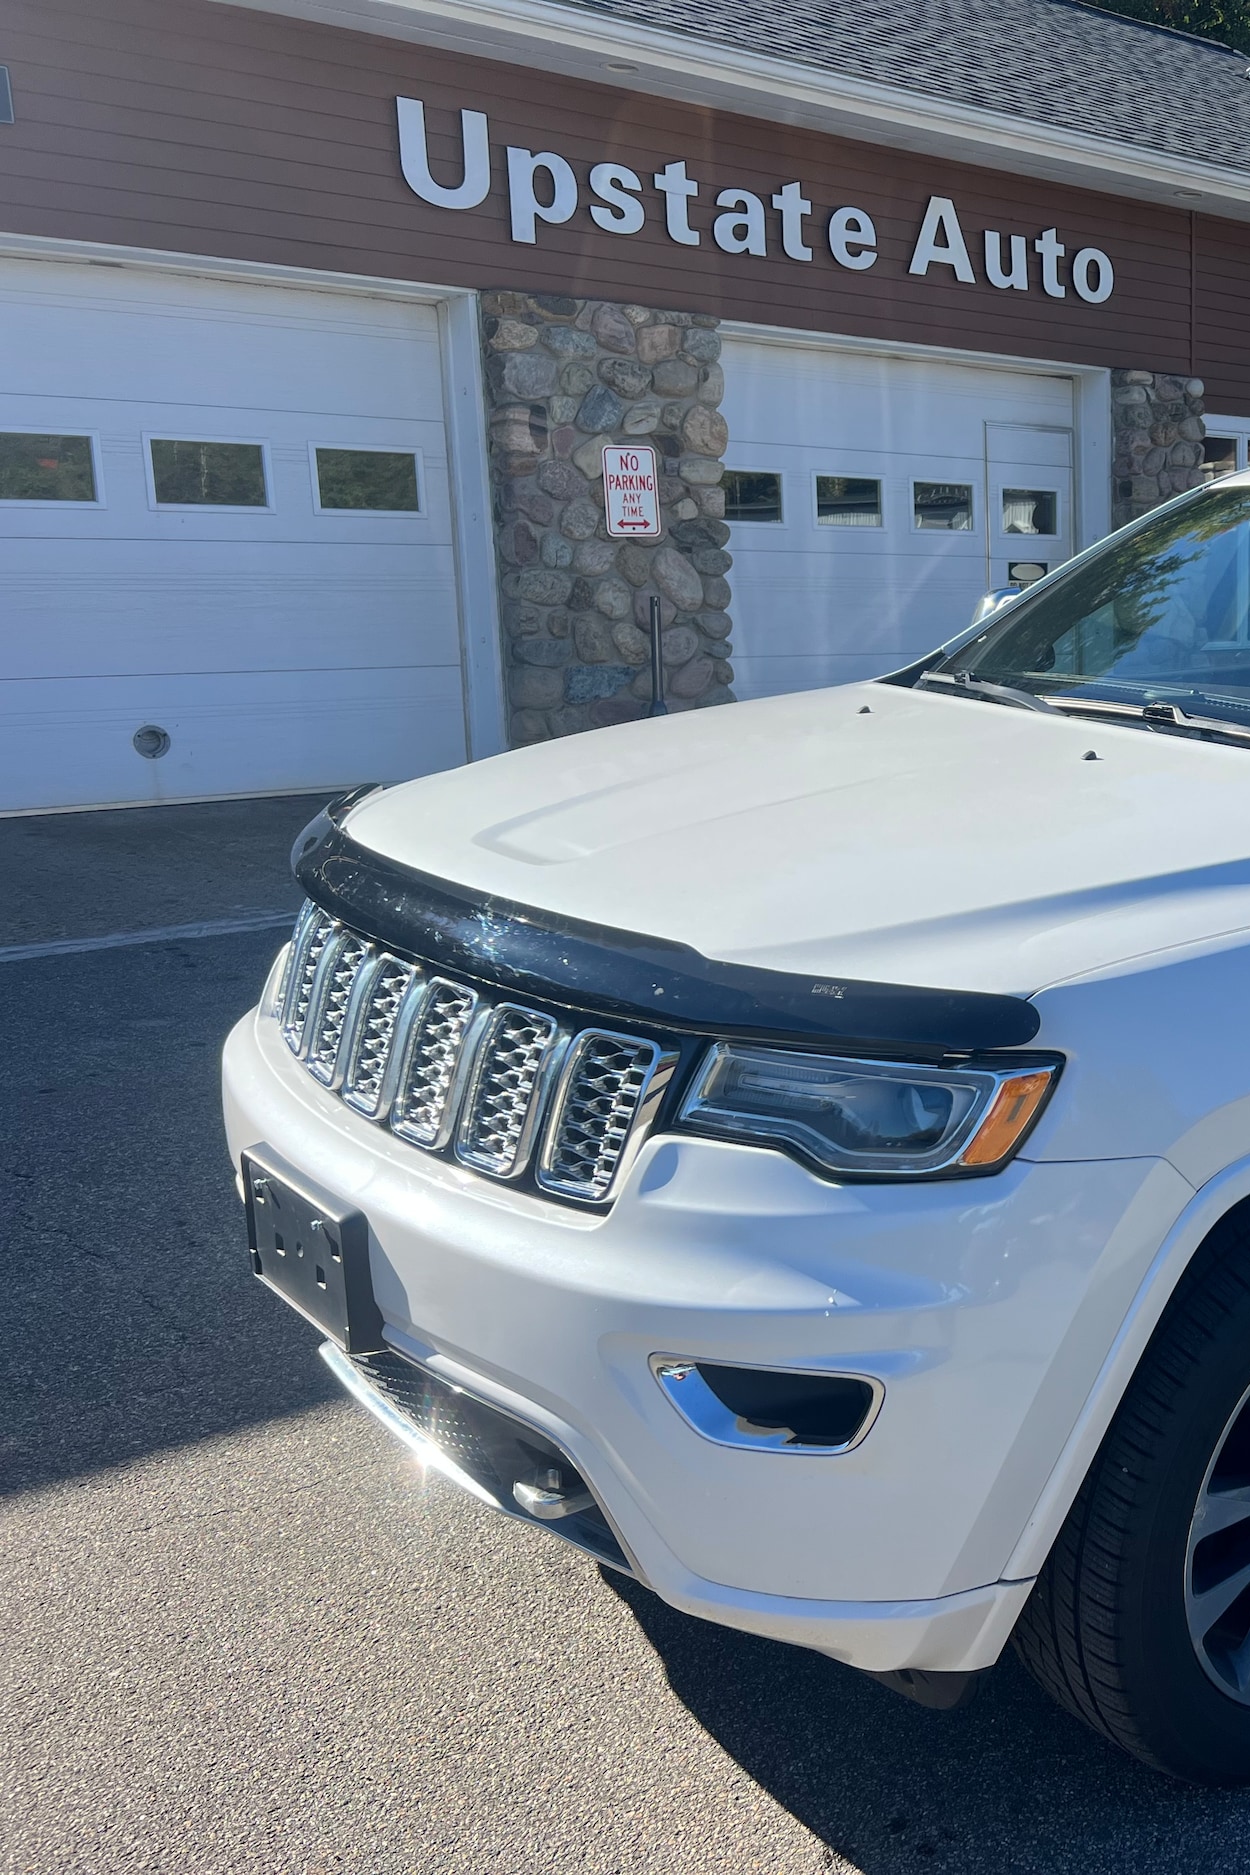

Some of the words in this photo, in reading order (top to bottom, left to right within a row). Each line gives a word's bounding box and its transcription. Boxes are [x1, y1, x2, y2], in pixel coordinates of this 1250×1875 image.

[395, 95, 878, 271] Upstate
[908, 195, 1115, 305] Auto
[619, 455, 639, 471] NO
[608, 474, 653, 491] PARKING
[622, 493, 642, 504] ANY
[622, 506, 645, 517] TIME
